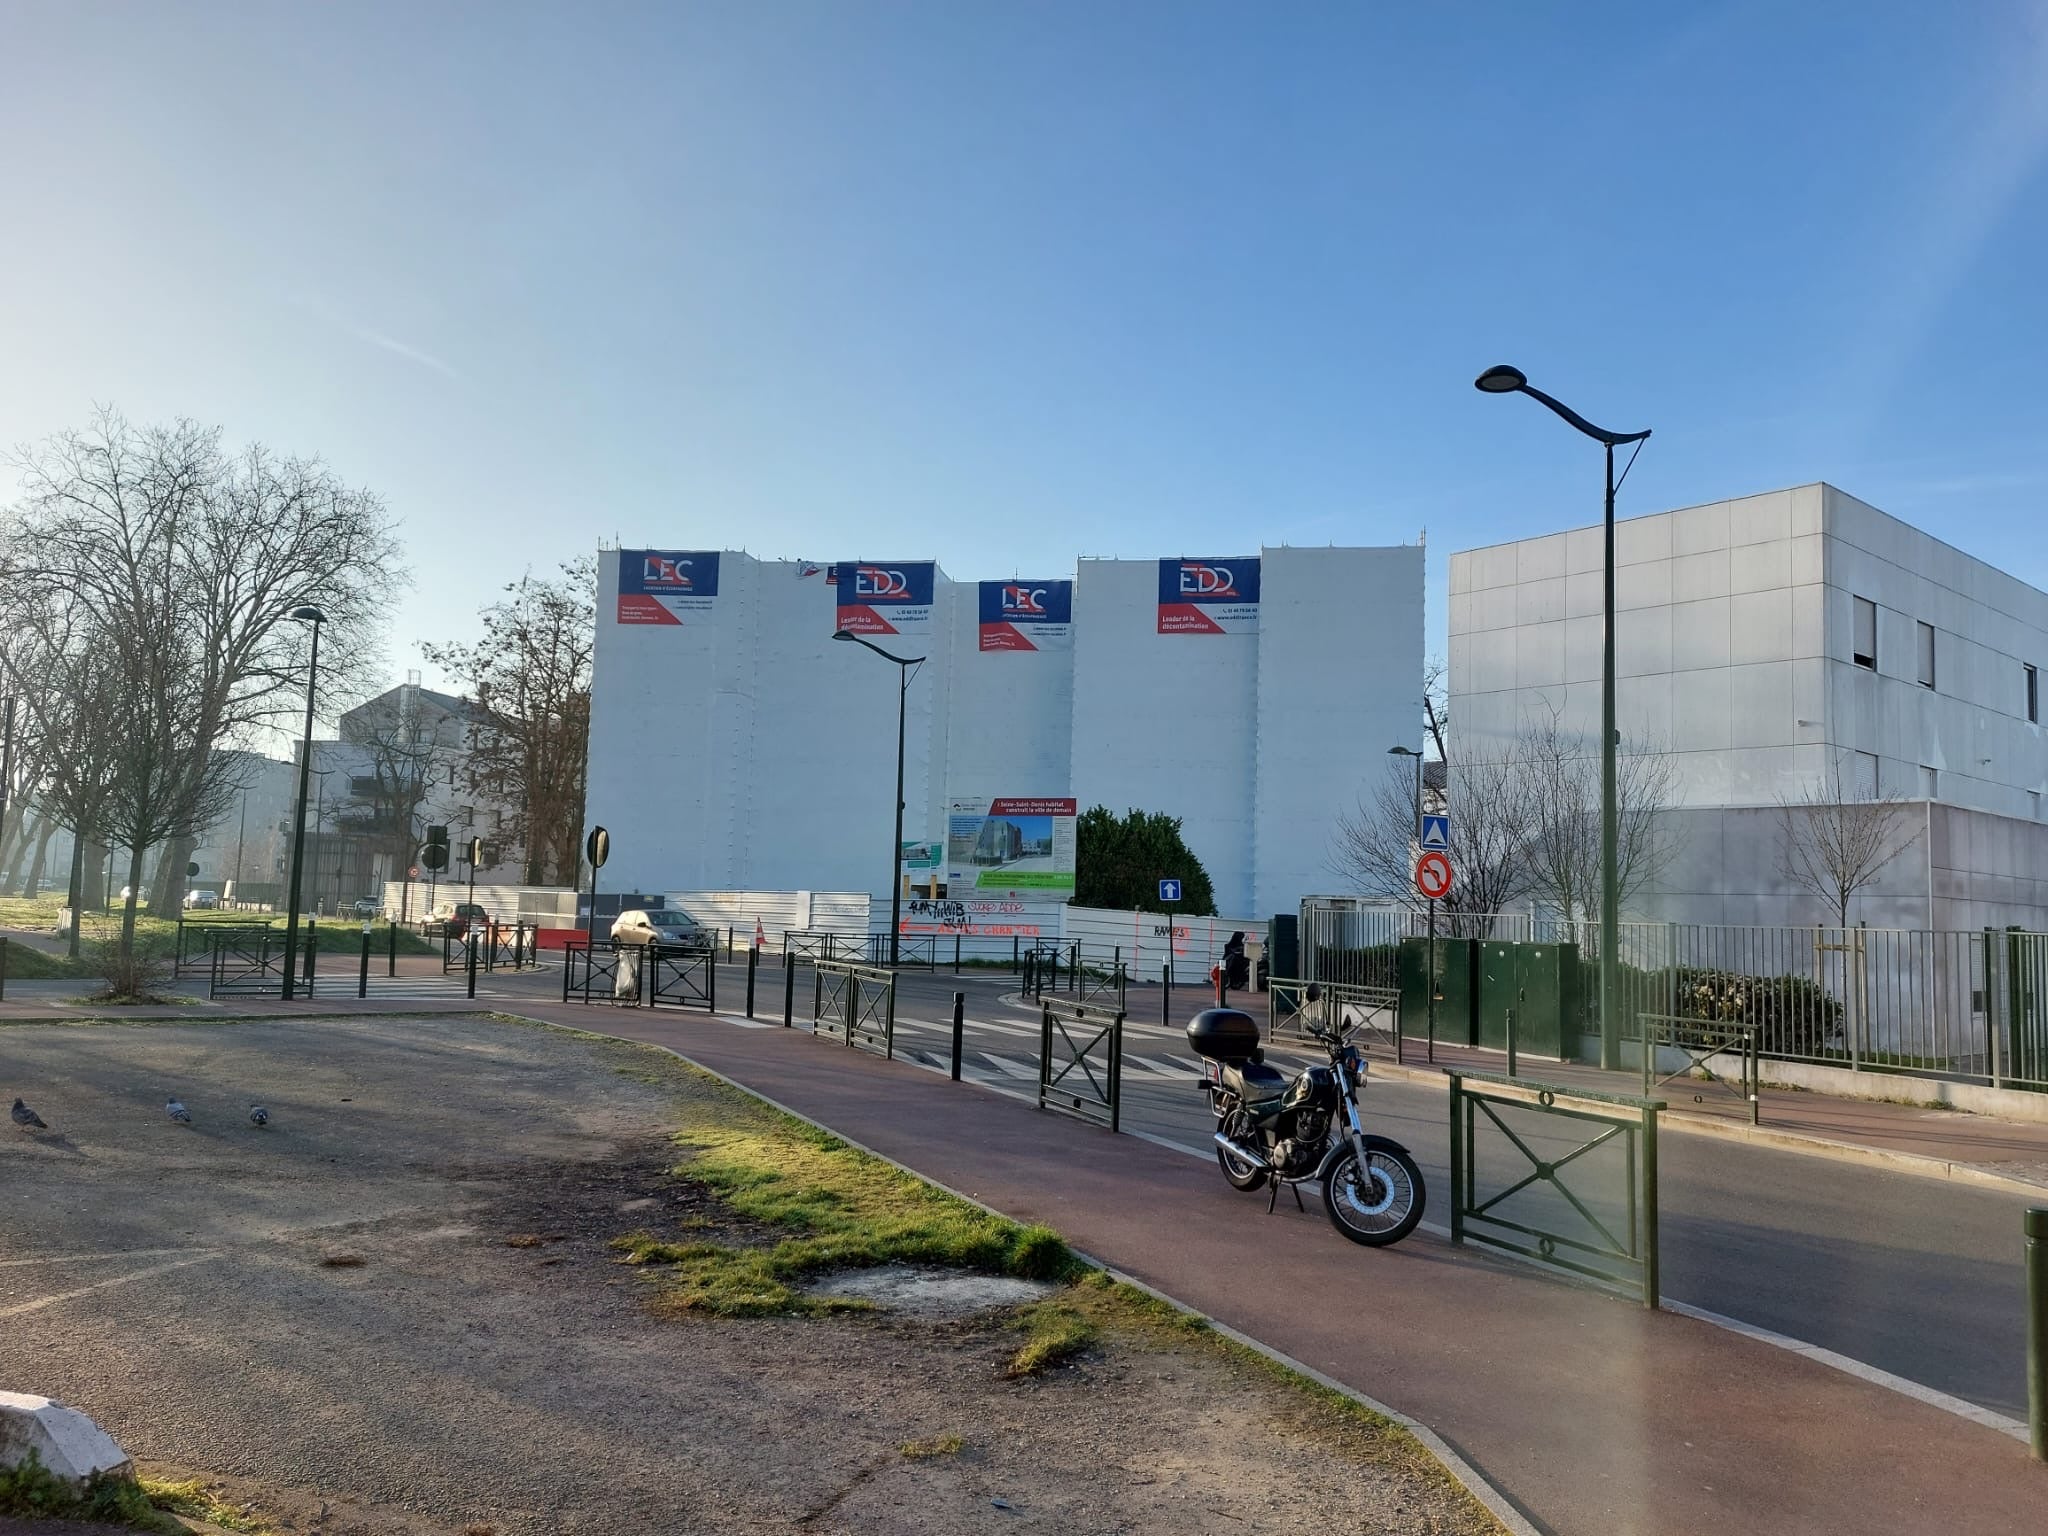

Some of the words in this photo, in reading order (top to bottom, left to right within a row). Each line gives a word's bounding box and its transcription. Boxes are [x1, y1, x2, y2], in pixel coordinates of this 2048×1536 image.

[644, 558, 694, 581] LEC
[1180, 567, 1234, 593] EDD
[856, 569, 907, 595] EDD
[1002, 588, 1047, 609] LEC
